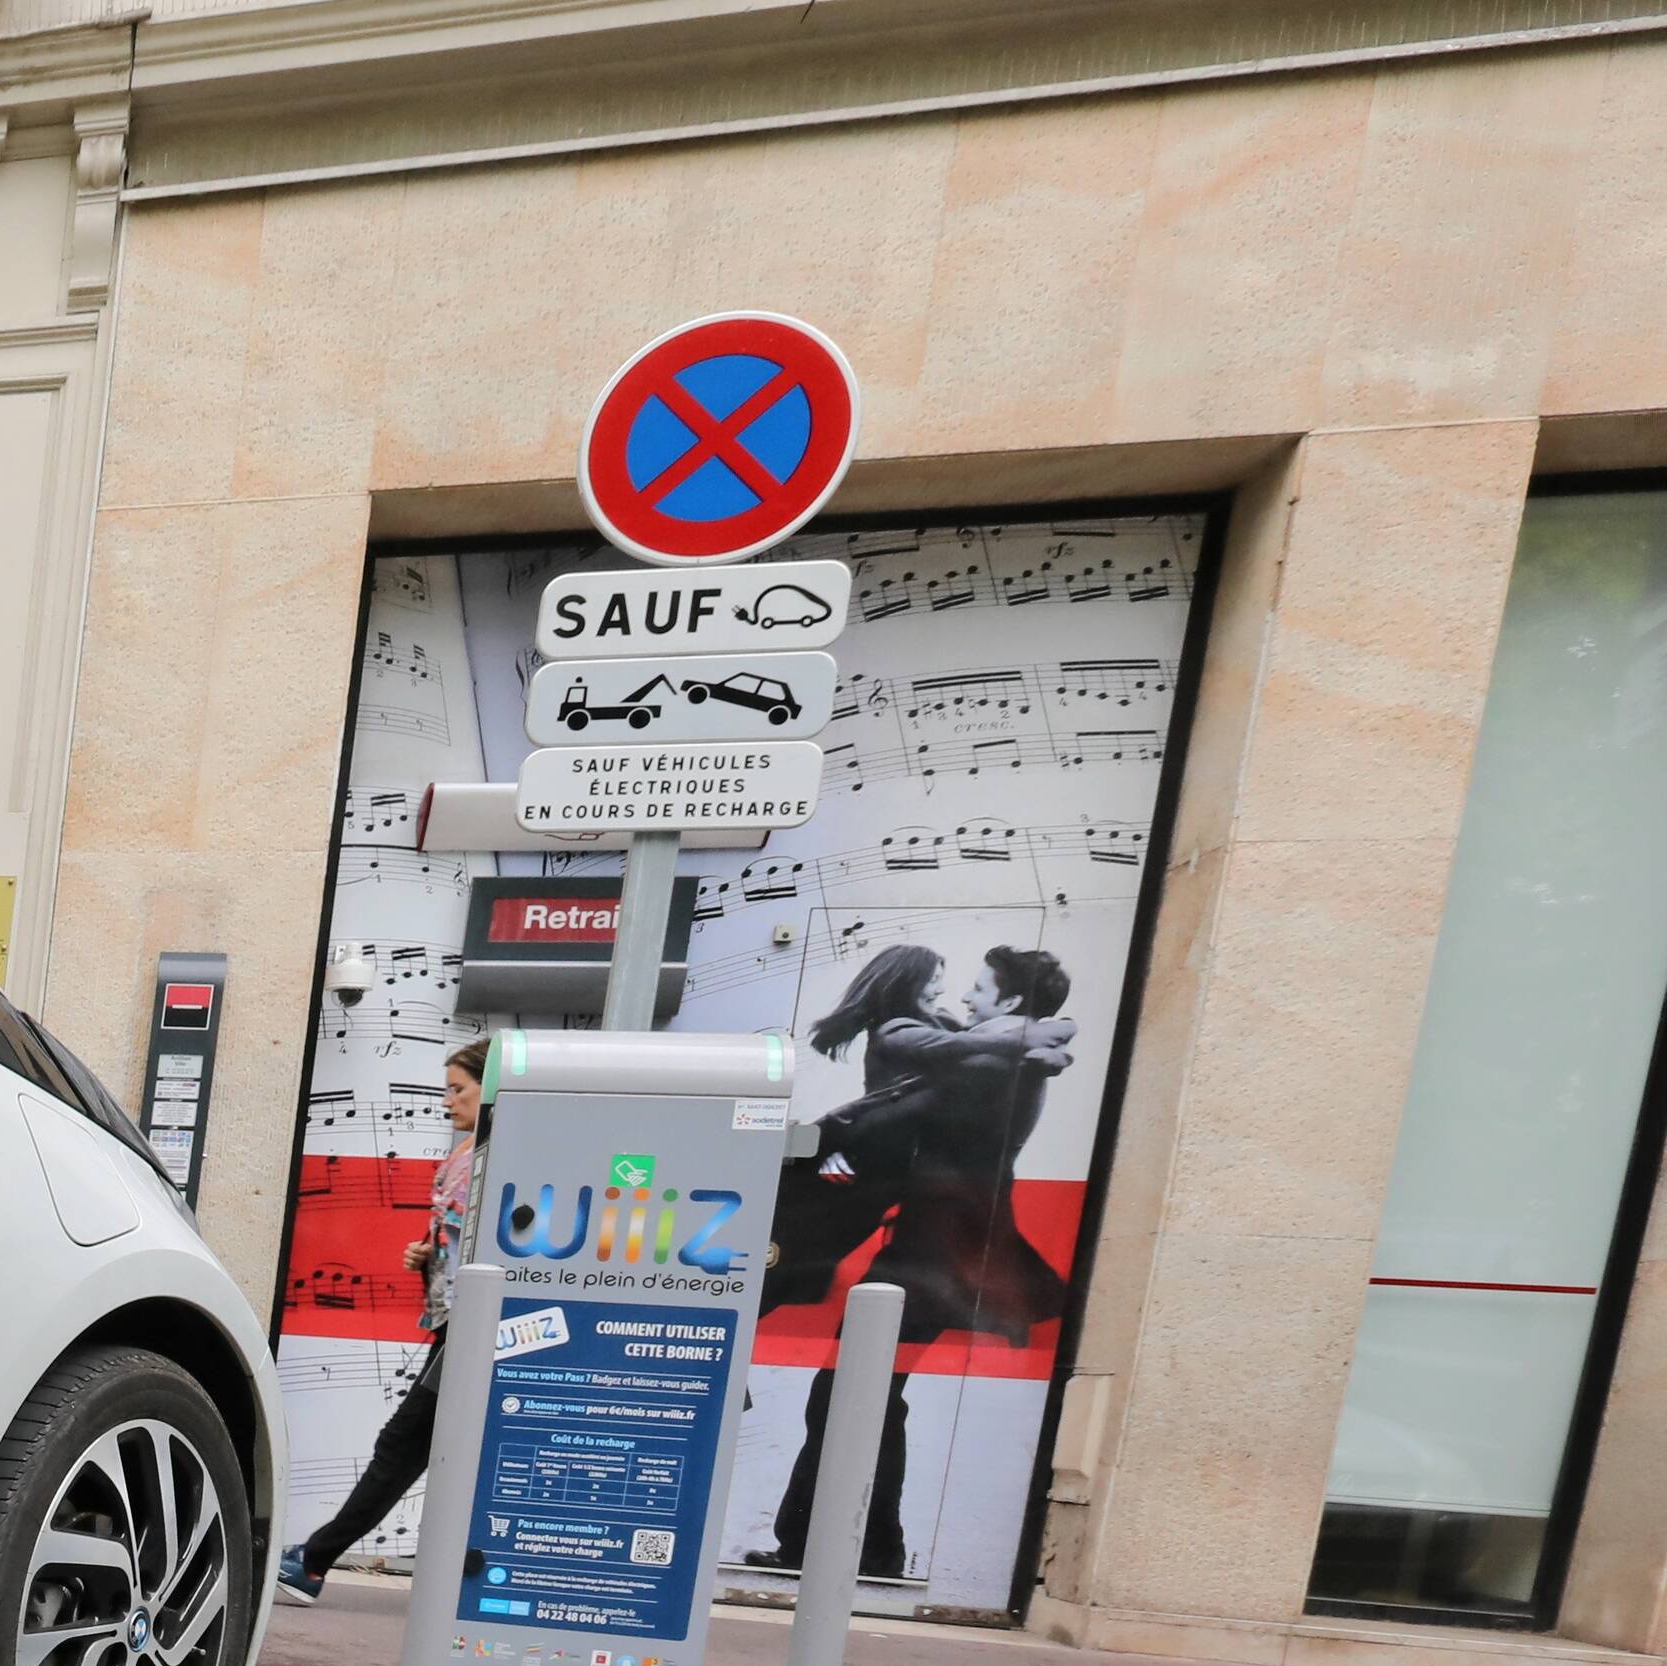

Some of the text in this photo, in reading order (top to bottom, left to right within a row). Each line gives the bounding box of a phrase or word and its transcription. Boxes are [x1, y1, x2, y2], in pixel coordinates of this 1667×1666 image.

[553, 588, 722, 638] SAUF
[572, 752, 772, 774] SAUF VÉHICULES
[589, 776, 746, 796] ÉLECTRIQUES
[524, 800, 809, 820] EN COURS DE RECHARGE
[524, 904, 621, 929] Retrai
[501, 1266, 745, 1297] aites le plein d'énergie
[595, 1320, 726, 1341] COMMENT UTILISER
[623, 1342, 722, 1360] CETTE BORNE ?
[496, 1368, 518, 1378] Vous
[518, 1370, 539, 1379] avez
[539, 1371, 563, 1380] votre
[564, 1372, 585, 1382] Pass
[591, 1374, 621, 1386] Badgez
[631, 1377, 680, 1388] laissez-vous
[680, 1379, 710, 1392] guider.
[523, 1399, 585, 1413] Abonnez-vous
[585, 1405, 608, 1416] pour
[646, 1409, 661, 1417] sur
[550, 1433, 635, 1449] Coût de la recharge
[517, 1519, 533, 1528] Pas
[534, 1521, 563, 1531] encore
[565, 1523, 603, 1534] membre
[515, 1531, 558, 1543] Connectez
[558, 1536, 578, 1544] vous
[514, 1541, 603, 1558] et réglez votre charge
[537, 1600, 547, 1608] En
[558, 1602, 567, 1610] de
[536, 1609, 550, 1619] 04
[550, 1610, 564, 1620] 22
[564, 1611, 578, 1621] 48
[578, 1612, 592, 1622] 04
[593, 1613, 607, 1624] 06
